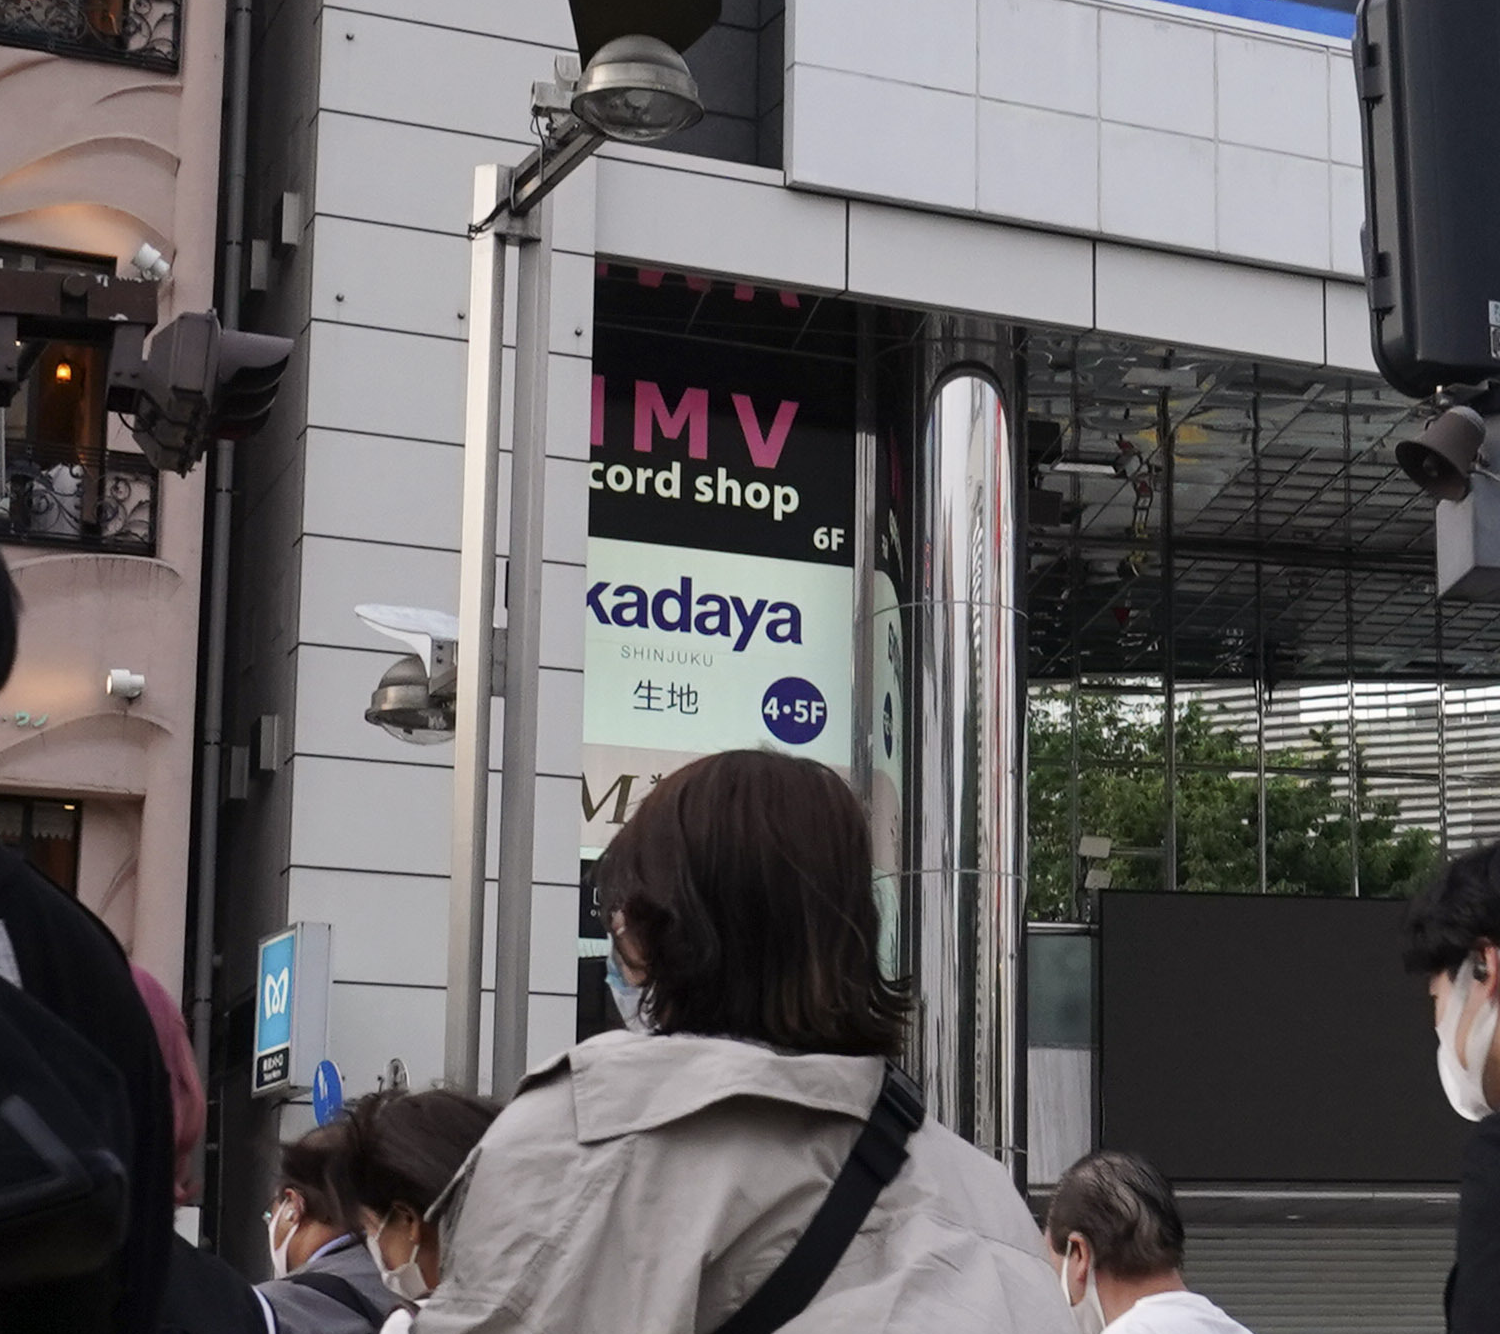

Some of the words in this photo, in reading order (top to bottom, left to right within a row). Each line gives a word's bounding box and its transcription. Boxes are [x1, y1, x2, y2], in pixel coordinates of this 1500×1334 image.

[694, 467, 800, 521] shop
[813, 527, 845, 551] 6F
[620, 645, 714, 667] SHINJUKU
[633, 679, 699, 715] 生地
